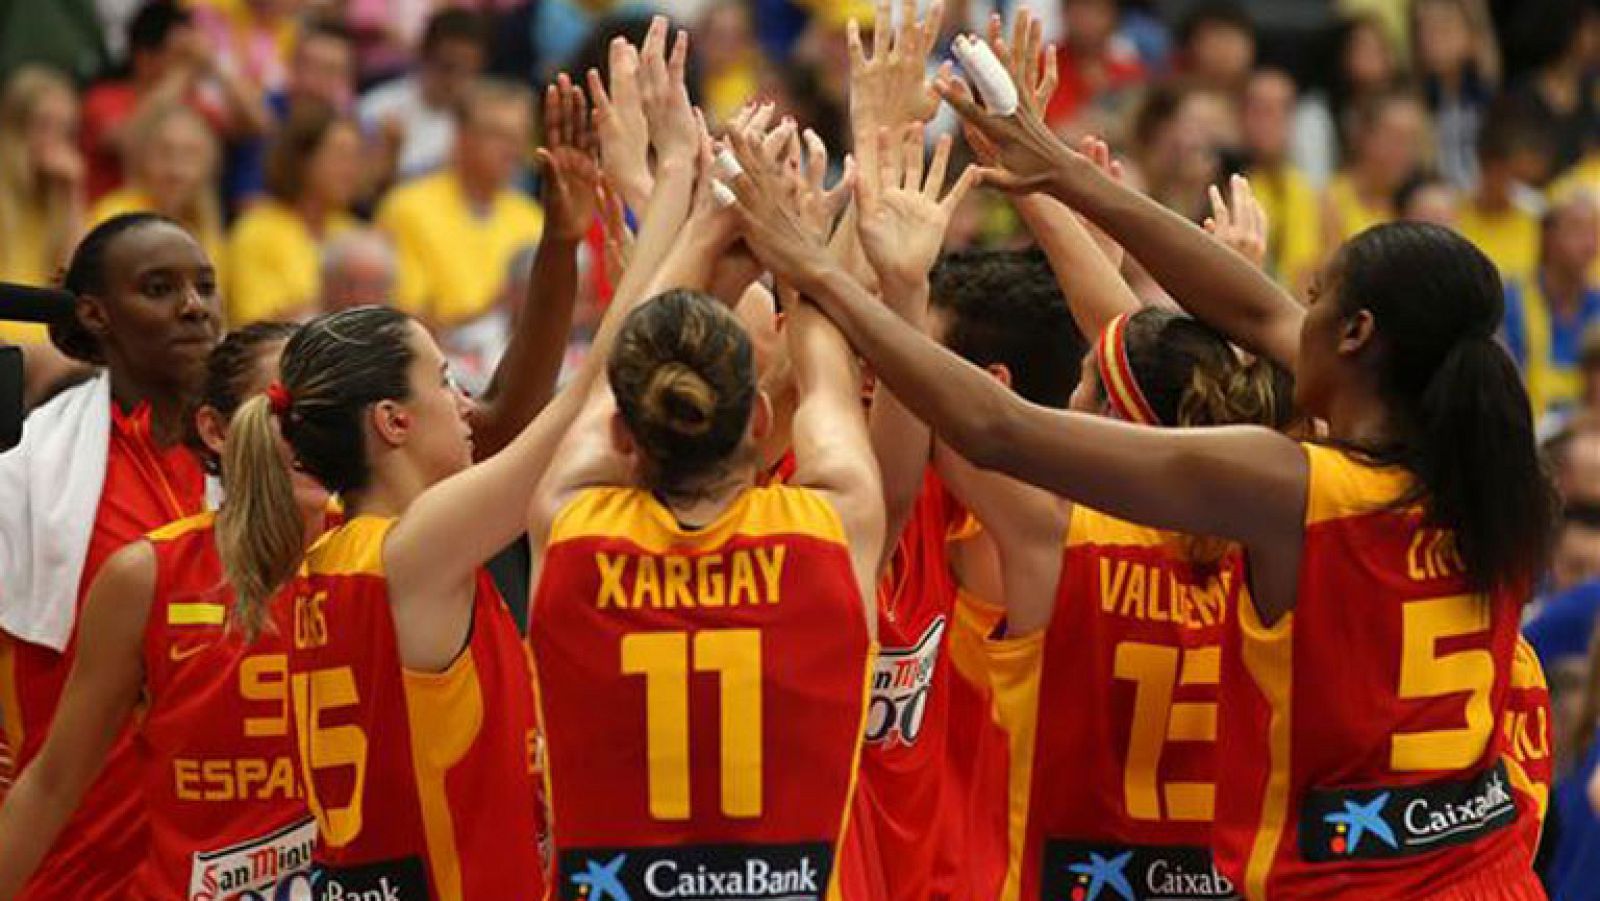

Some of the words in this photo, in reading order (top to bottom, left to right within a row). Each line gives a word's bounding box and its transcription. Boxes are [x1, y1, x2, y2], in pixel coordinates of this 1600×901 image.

[595, 544, 788, 609] XARGAY
[620, 629, 763, 820] 11
[1390, 595, 1495, 771] 5
[174, 758, 303, 801] ESPA
[291, 665, 368, 848] 15
[643, 857, 818, 898] CaixaBank
